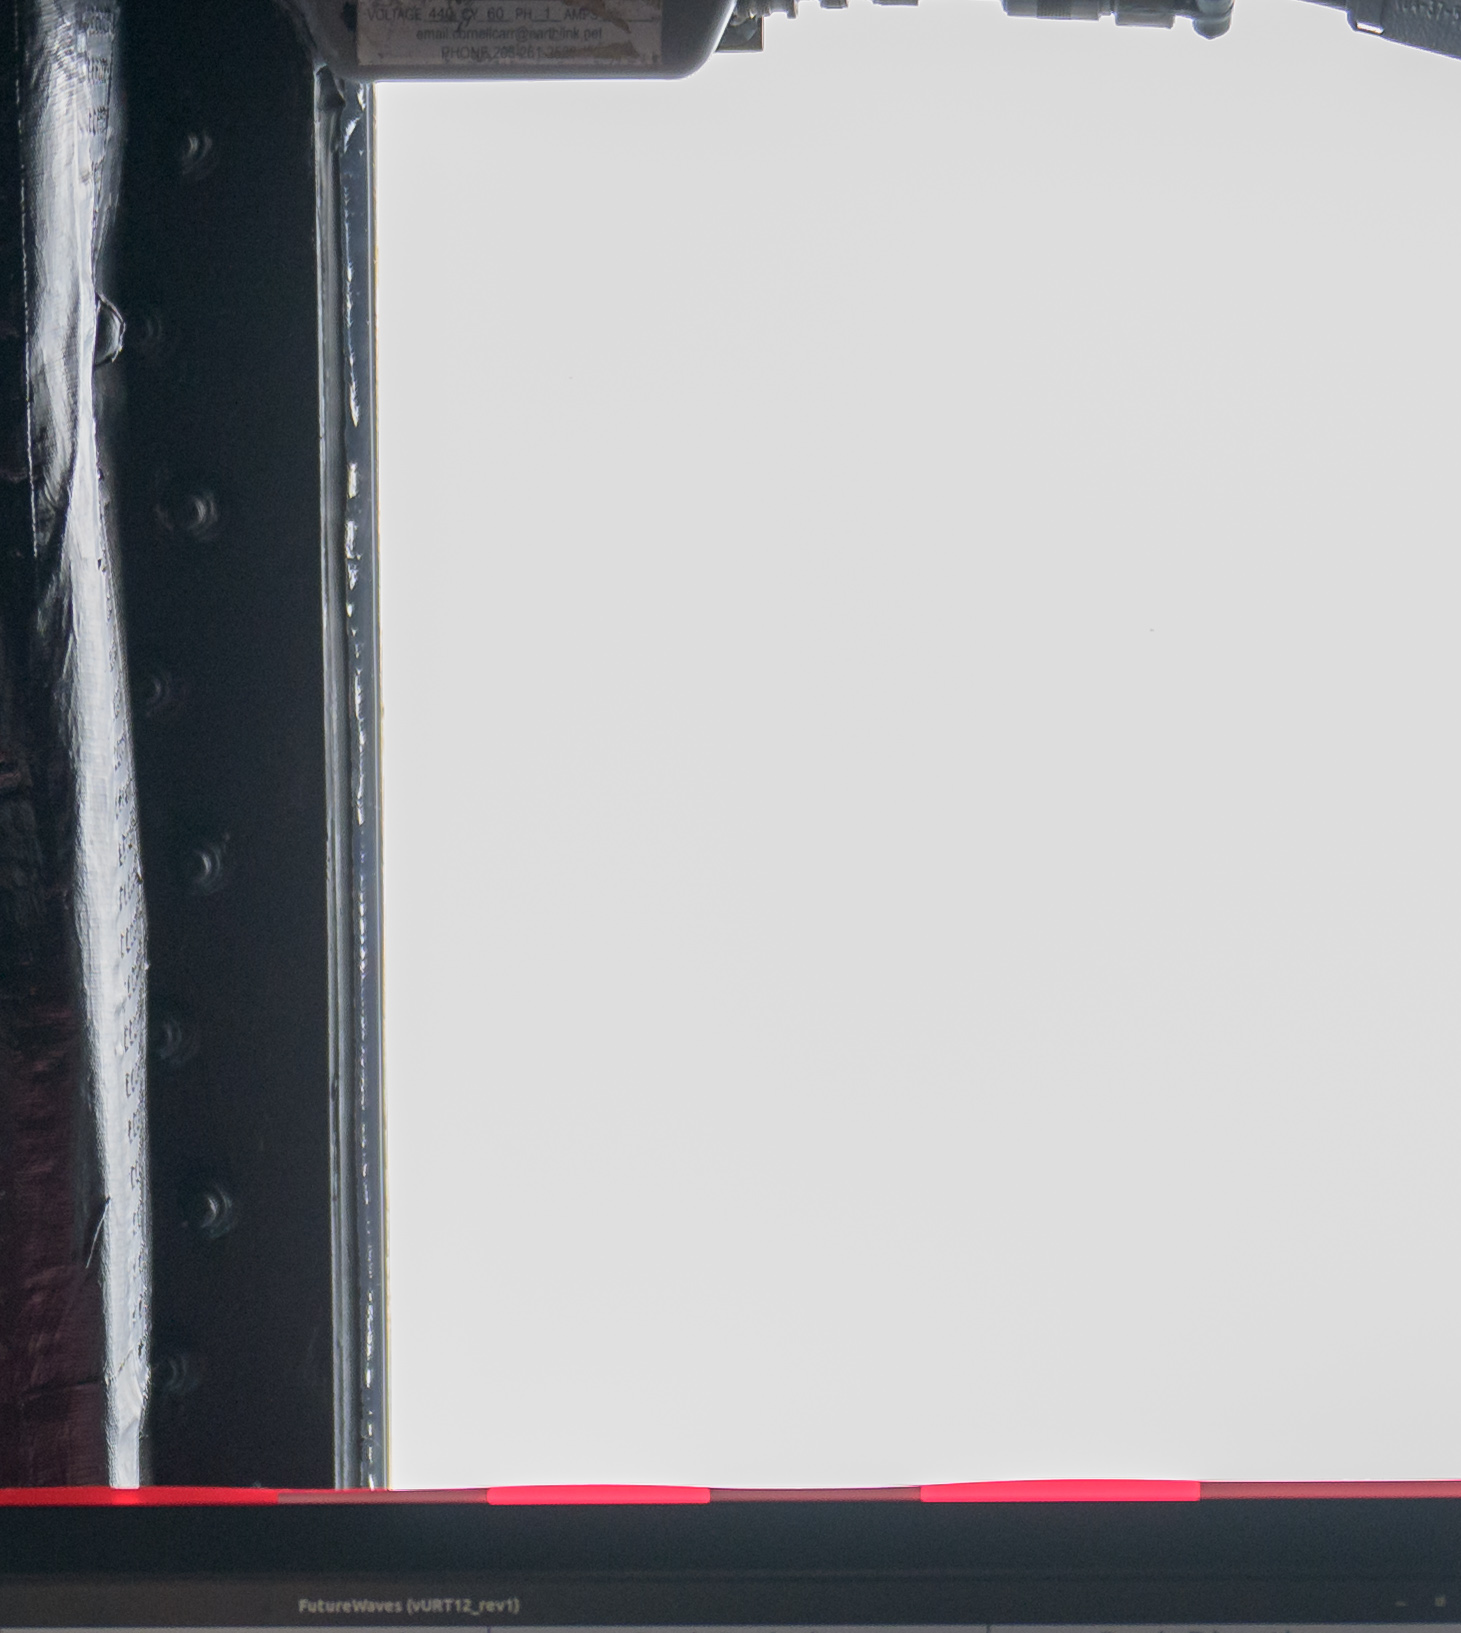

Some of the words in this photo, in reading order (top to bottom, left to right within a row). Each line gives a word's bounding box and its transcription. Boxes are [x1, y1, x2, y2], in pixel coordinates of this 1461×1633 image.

[368, 8, 422, 21] VOLTAGE
[487, 8, 504, 20] 60
[515, 8, 532, 20] PH
[299, 1599, 403, 1614] FutureWaves
